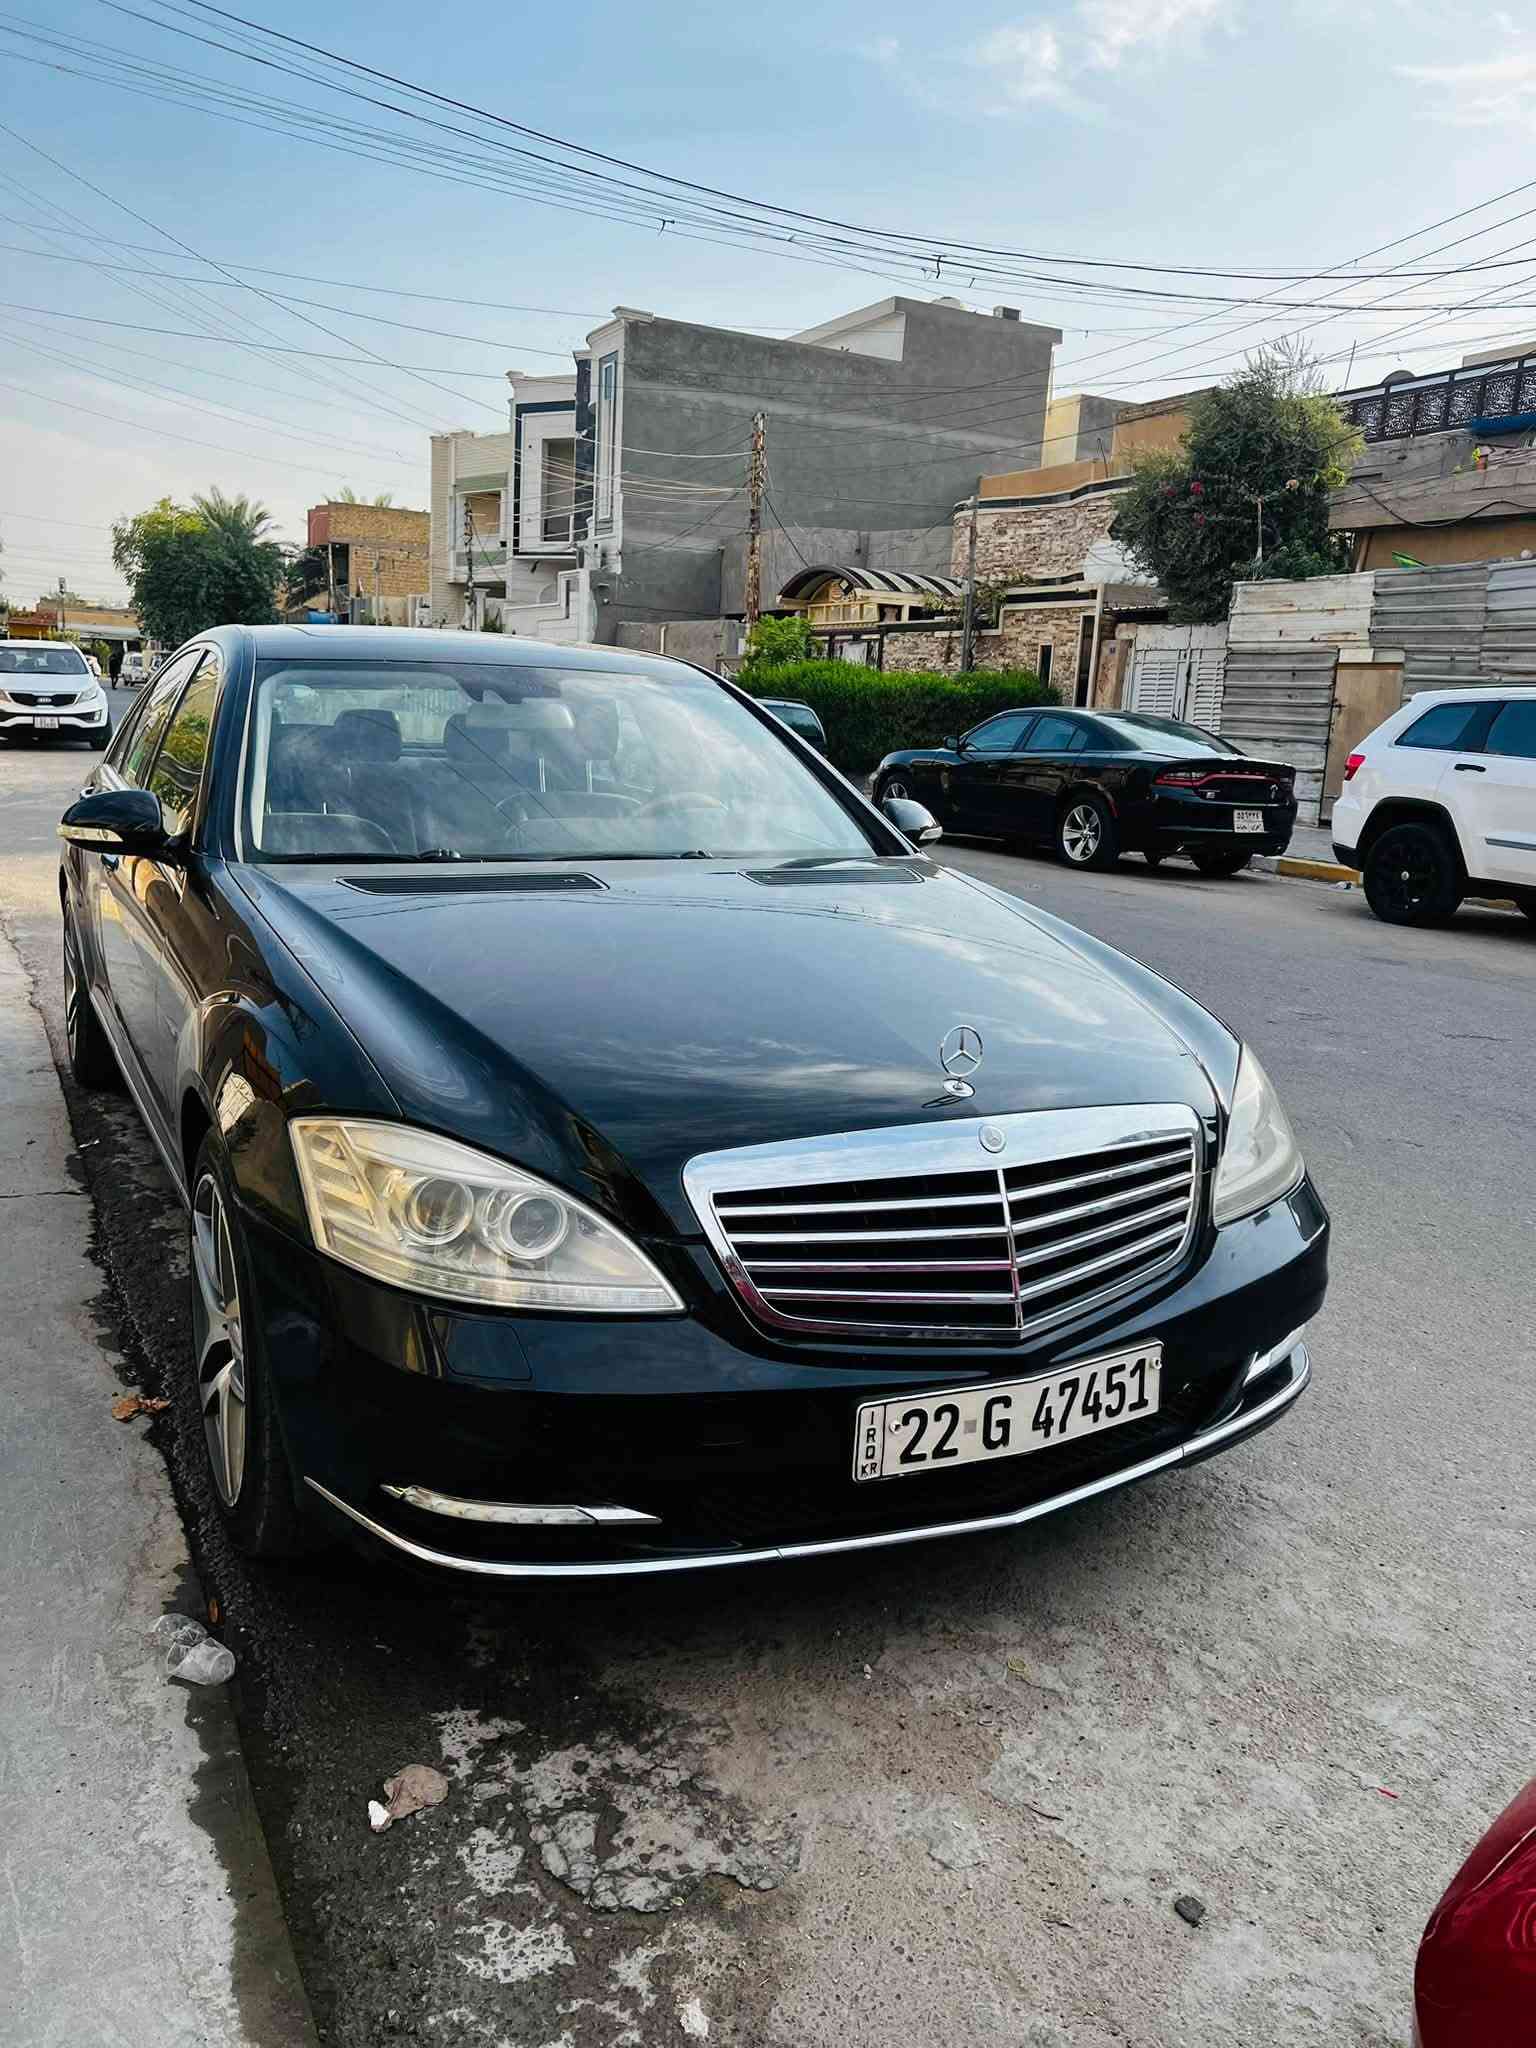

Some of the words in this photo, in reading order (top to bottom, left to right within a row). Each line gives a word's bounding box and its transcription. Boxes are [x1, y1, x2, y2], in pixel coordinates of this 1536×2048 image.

[865, 1410, 877, 1460] IRQ
[899, 1403, 960, 1465] 22
[982, 1395, 1013, 1450] G
[1031, 1357, 1150, 1438] 47451
[861, 1461, 878, 1476] KR
